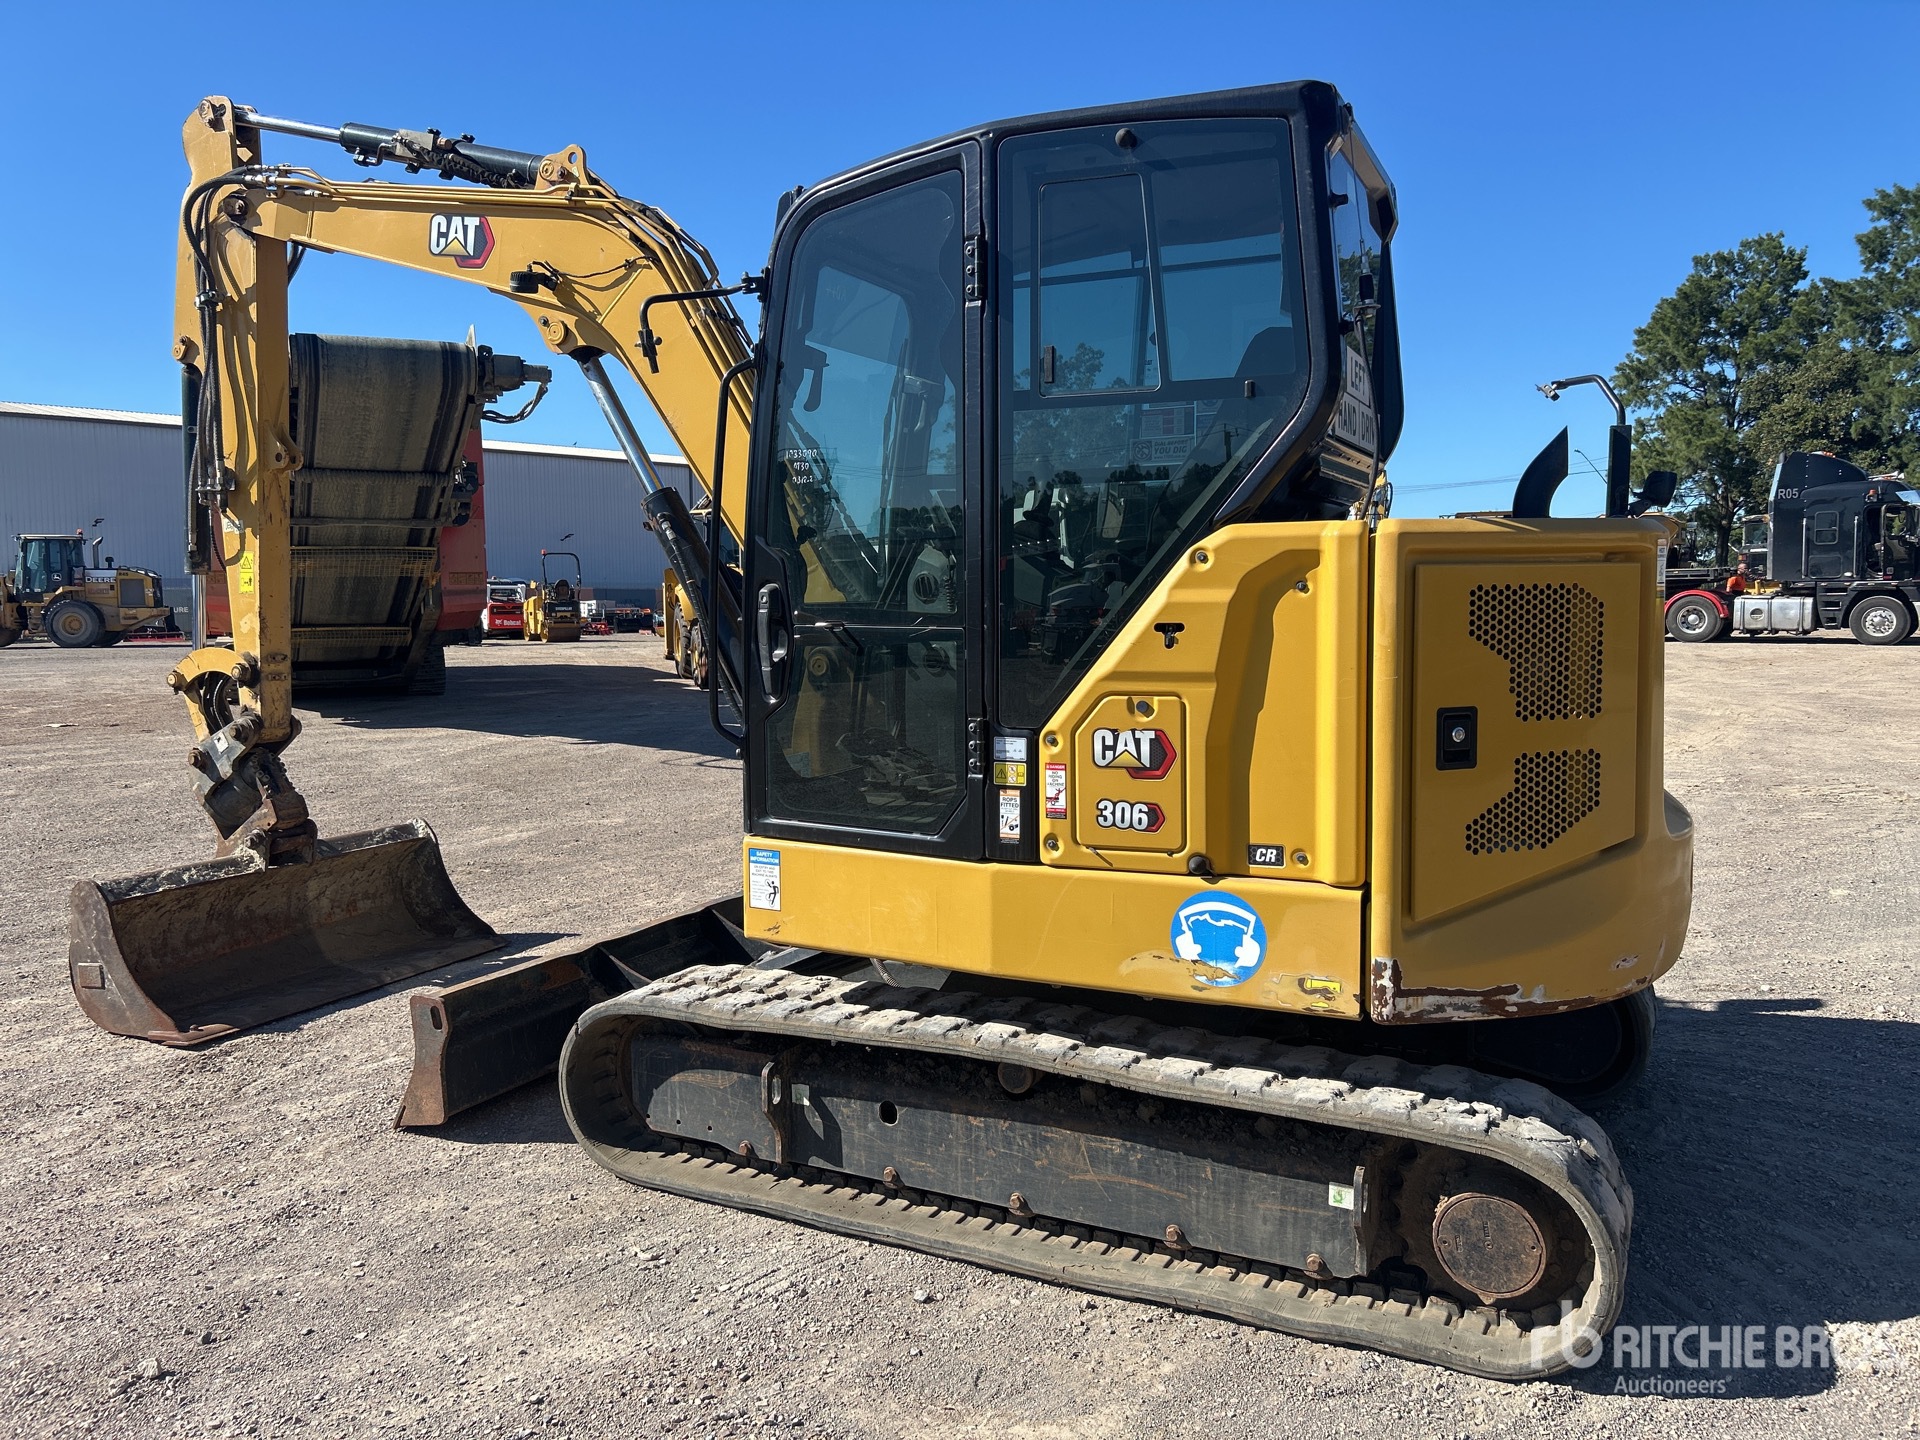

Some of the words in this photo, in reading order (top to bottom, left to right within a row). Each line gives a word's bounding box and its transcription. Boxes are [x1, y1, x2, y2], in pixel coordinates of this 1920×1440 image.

[430, 214, 480, 256] CAT
[1350, 355, 1366, 397] LEFT
[1338, 400, 1357, 437] HAND
[1154, 446, 1171, 455] YOU
[1173, 446, 1188, 454] DIG
[1777, 488, 1799, 500] R05
[1092, 728, 1157, 768] CAT
[1097, 799, 1150, 832] 306
[1255, 847, 1278, 864] CR
